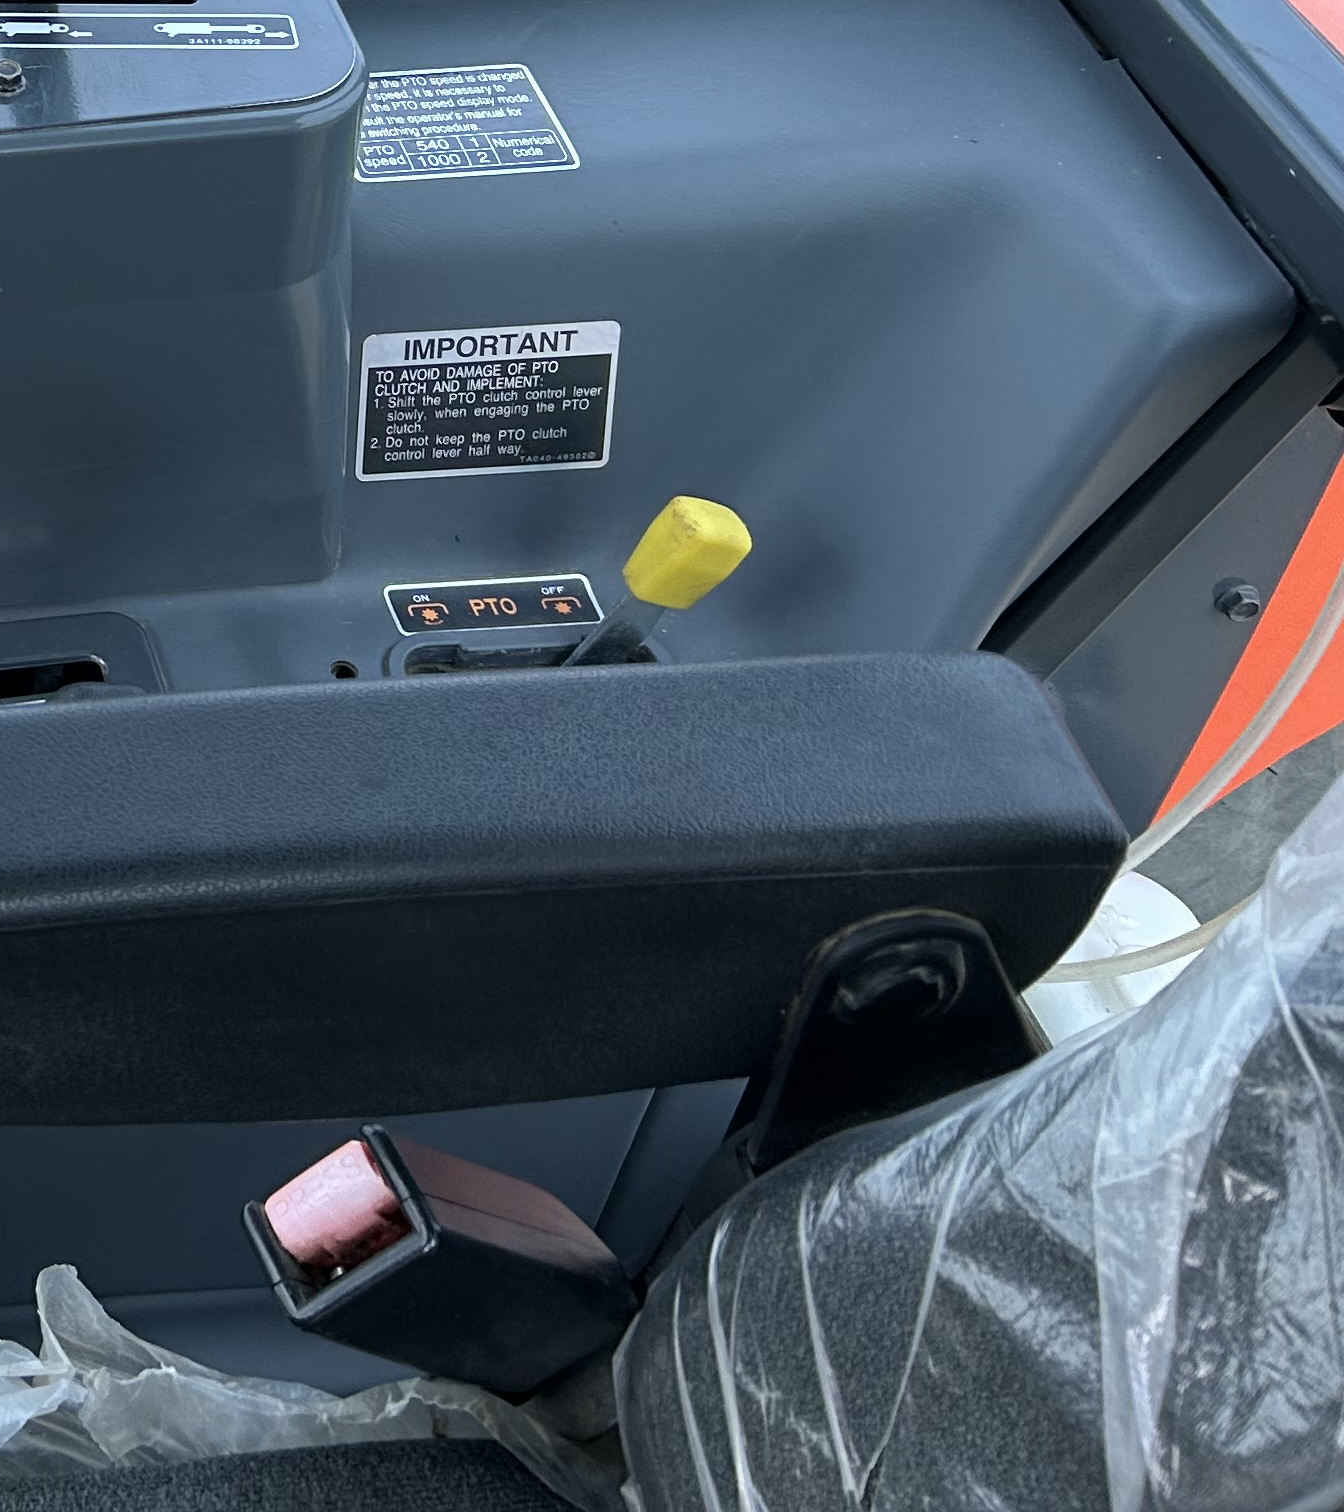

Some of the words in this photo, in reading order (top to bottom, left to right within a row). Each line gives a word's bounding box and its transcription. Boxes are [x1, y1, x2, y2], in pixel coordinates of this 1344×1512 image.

[381, 79, 400, 88] the
[400, 76, 427, 87] PTO
[429, 74, 464, 87] speed
[465, 74, 476, 83] is
[477, 71, 526, 83] changed
[412, 88, 422, 98] it
[422, 87, 434, 97] is
[434, 85, 492, 96] necessary
[492, 84, 506, 93] to
[371, 102, 391, 113] the
[391, 100, 418, 111] PTO
[419, 98, 455, 110] speed
[456, 97, 494, 107] display
[496, 93, 533, 104] mode.
[385, 115, 405, 125] the
[406, 111, 463, 125] operator's
[463, 107, 506, 120] manual
[506, 106, 523, 117] for
[367, 126, 420, 137] switching
[421, 123, 482, 136] procedure.
[416, 139, 450, 151] 540
[469, 136, 480, 148] 1
[491, 134, 556, 148] Numerical
[362, 145, 395, 157] PTO
[476, 151, 492, 163] 2
[512, 146, 544, 157] code
[364, 154, 407, 169] speed
[417, 153, 461, 167] 1000
[404, 330, 579, 361] IMPORTANT
[375, 370, 394, 383] TO
[399, 368, 440, 383] AVOID
[446, 364, 502, 379] DAMAGE
[507, 362, 527, 376] OF
[532, 360, 559, 374] PTO
[374, 381, 427, 397] CLUTCH
[432, 379, 460, 393] AND
[466, 374, 544, 391] IMPLEMENT:
[374, 398, 384, 409] 1.
[387, 395, 415, 408] Shift
[422, 394, 441, 407] the
[448, 391, 476, 405] PTO
[482, 390, 518, 403] clutch
[525, 386, 566, 400] control
[572, 385, 603, 398] lever
[435, 407, 467, 419] when
[473, 404, 529, 419] engaging
[536, 401, 555, 413] the
[562, 398, 590, 411] PTO
[386, 421, 424, 435] clutch.
[370, 437, 382, 449] 2.
[385, 436, 403, 448] Do
[409, 435, 429, 447] not
[436, 434, 465, 446] keep
[472, 432, 491, 444] the
[498, 428, 526, 441] PTO
[532, 427, 568, 440] clutch
[384, 448, 425, 462] control
[432, 447, 462, 459] lever
[468, 444, 491, 457] half
[497, 444, 524, 457] way.
[412, 594, 431, 603] ON
[540, 586, 565, 596] OFF
[468, 597, 518, 617] PTO
[274, 1152, 361, 1219] PRESS
